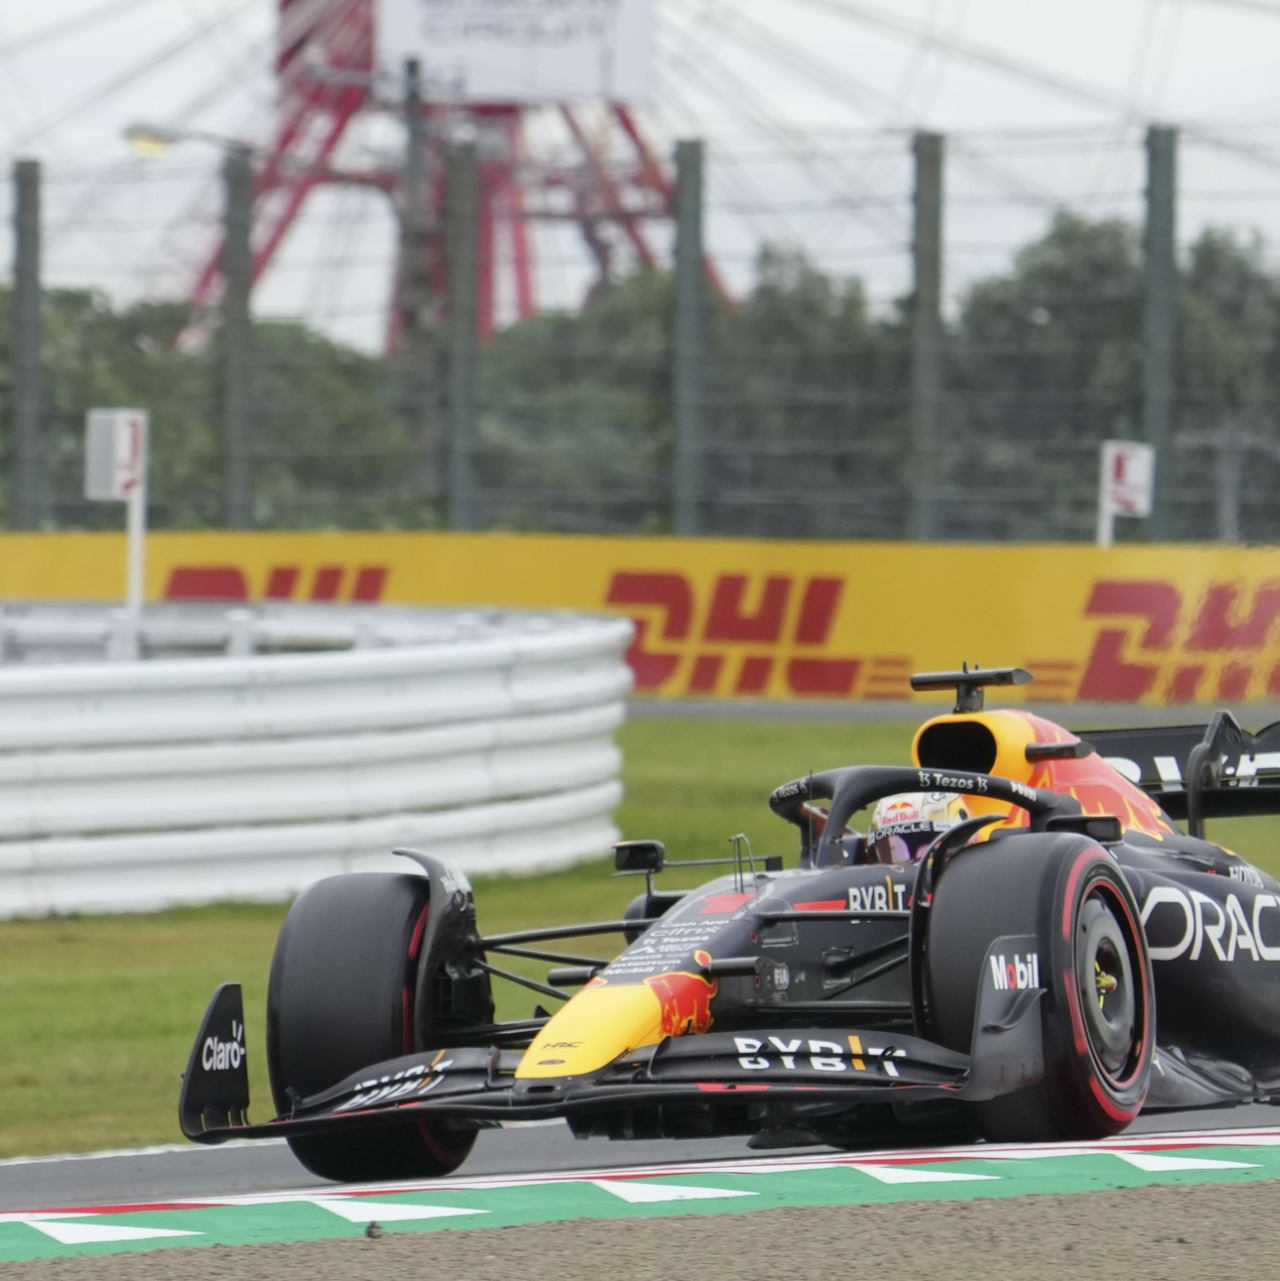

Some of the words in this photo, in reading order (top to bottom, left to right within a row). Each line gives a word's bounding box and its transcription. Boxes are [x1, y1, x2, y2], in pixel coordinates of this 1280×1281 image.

[606, 573, 862, 694] DHL
[933, 773, 974, 789] Tezos
[876, 821, 931, 840] ORACLE
[882, 815, 899, 825] Red
[900, 811, 920, 822] Bull
[847, 875, 906, 922] BYBIT
[989, 952, 1040, 991] Mobil
[202, 1029, 243, 1072] Claro
[733, 1035, 907, 1078] BYBIT
